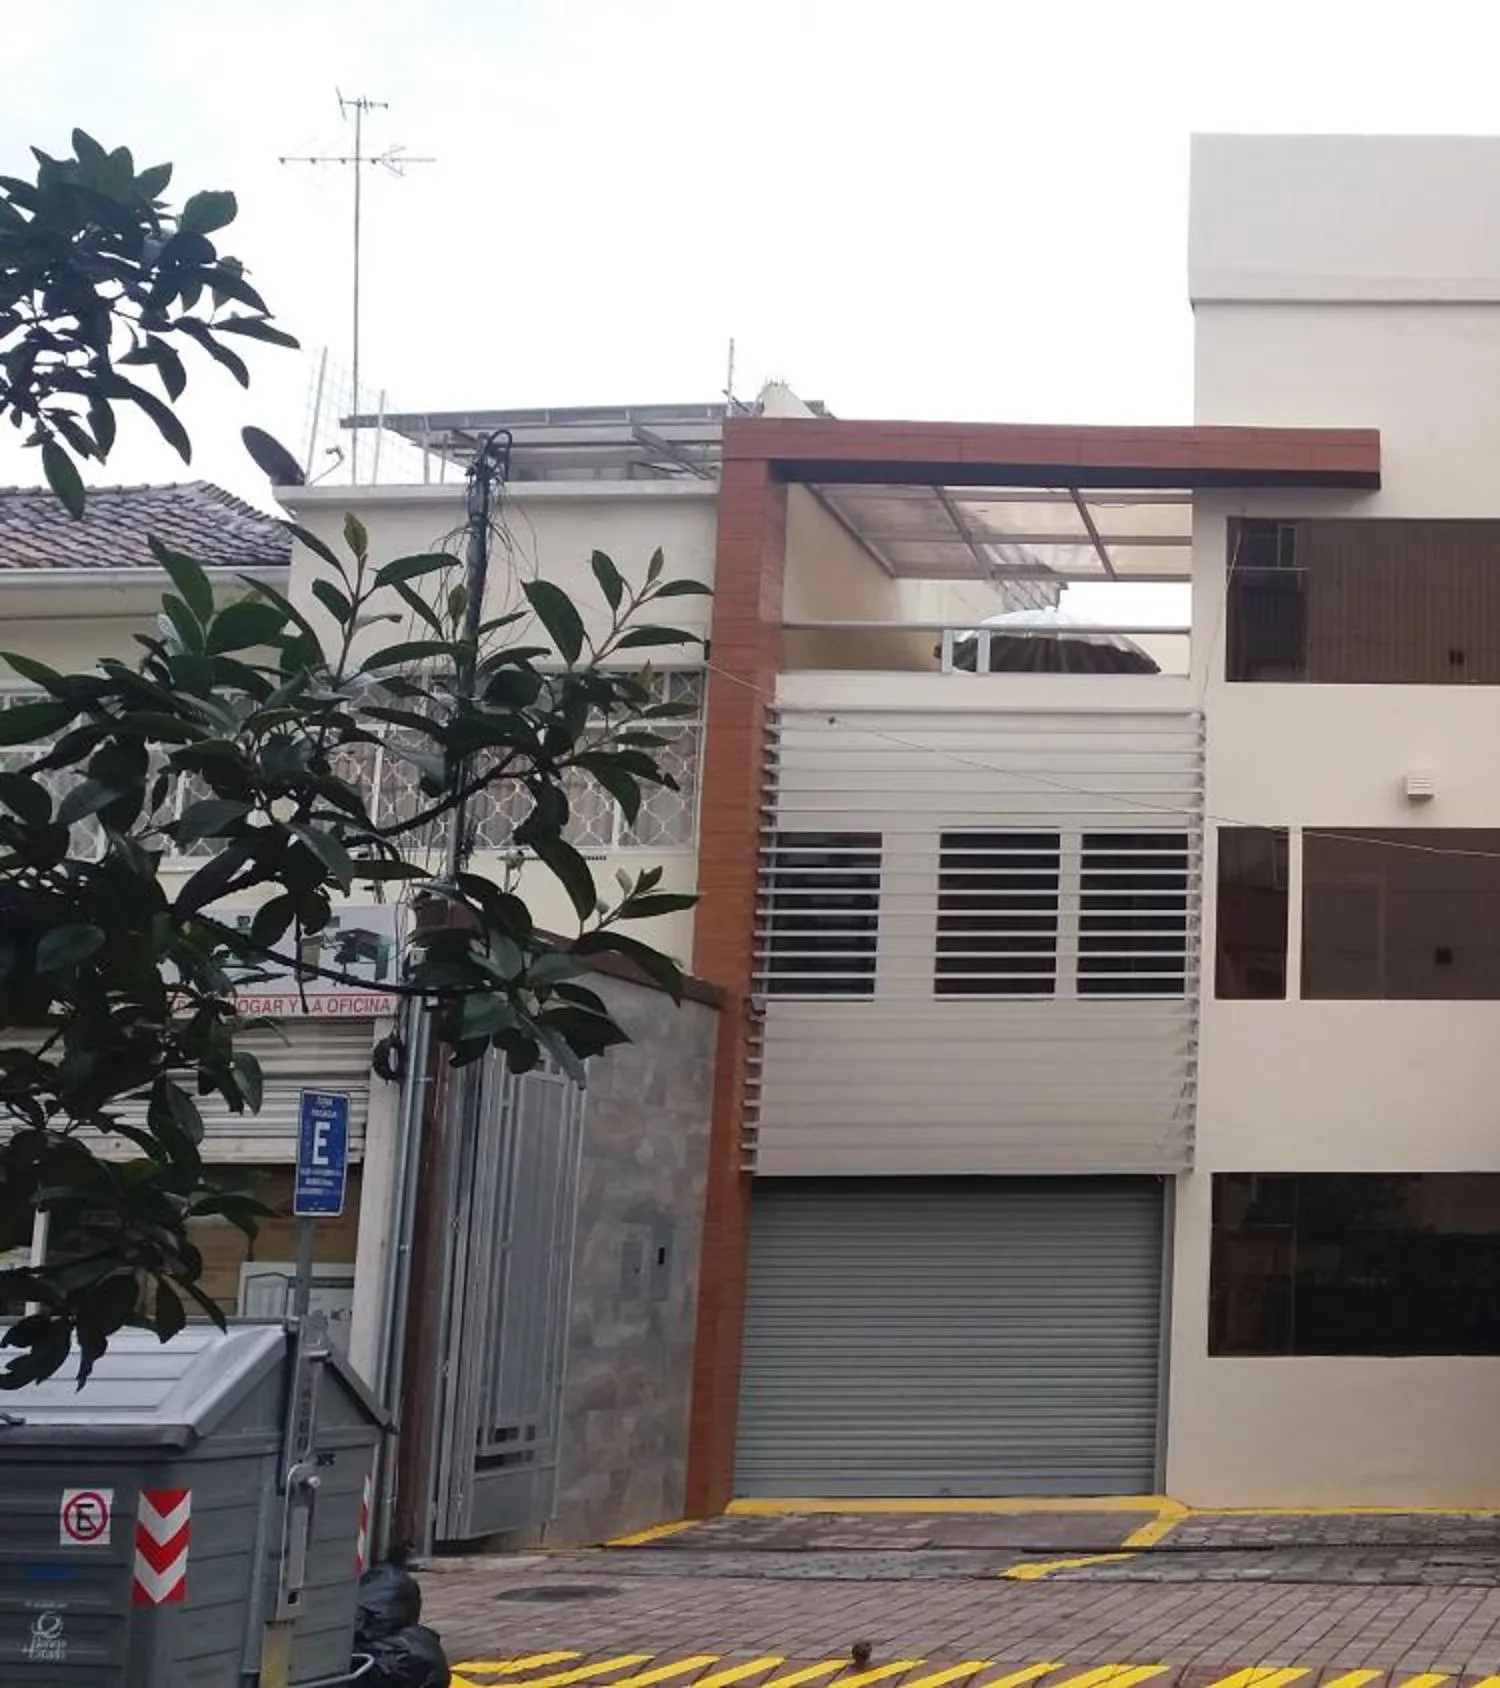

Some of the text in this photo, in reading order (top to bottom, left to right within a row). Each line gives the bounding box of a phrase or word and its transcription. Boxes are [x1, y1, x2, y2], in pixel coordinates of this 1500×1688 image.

[232, 999, 284, 1014] OGAR
[289, 999, 299, 1013] Y
[326, 998, 392, 1013] OFICINA
[311, 1120, 331, 1166] E
